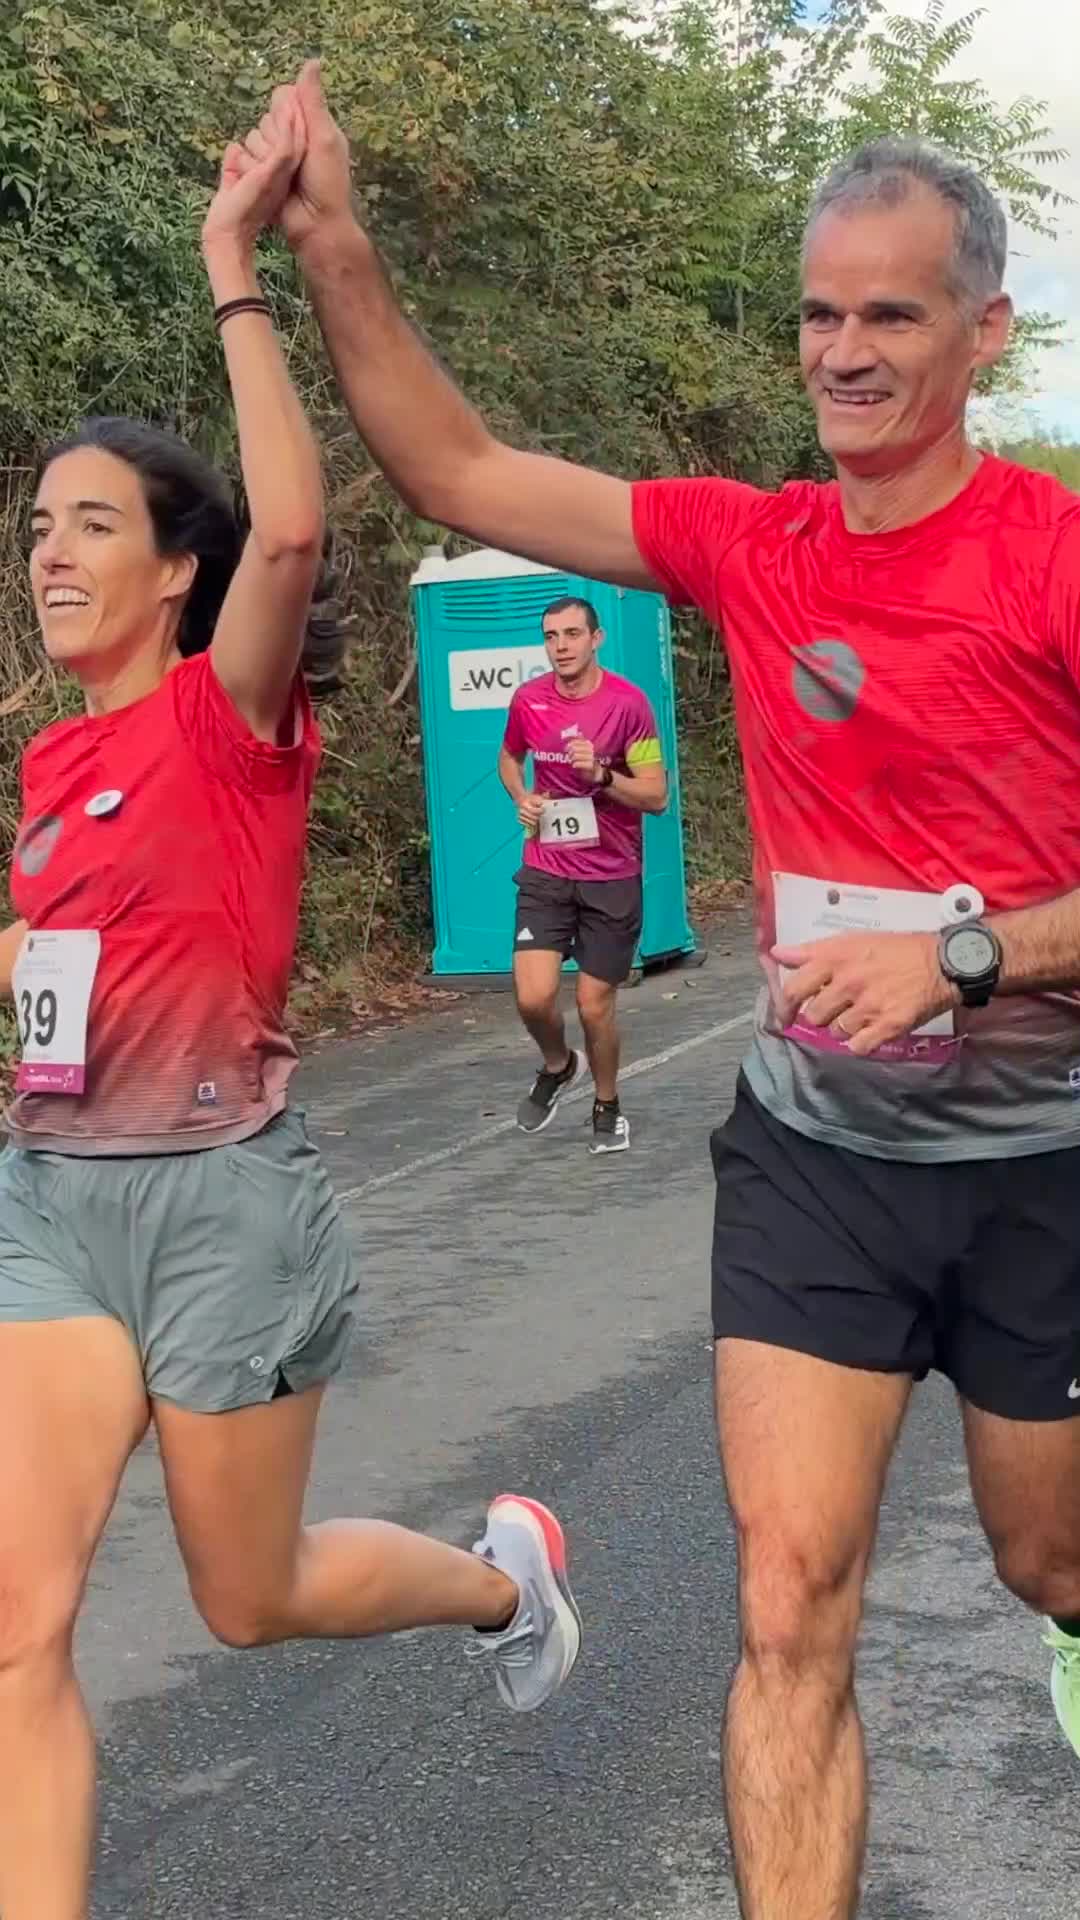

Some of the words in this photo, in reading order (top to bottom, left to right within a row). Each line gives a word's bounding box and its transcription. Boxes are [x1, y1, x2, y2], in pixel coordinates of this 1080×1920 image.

[467, 666, 512, 690] WC
[534, 751, 572, 764] ABORA
[551, 816, 580, 838] 19
